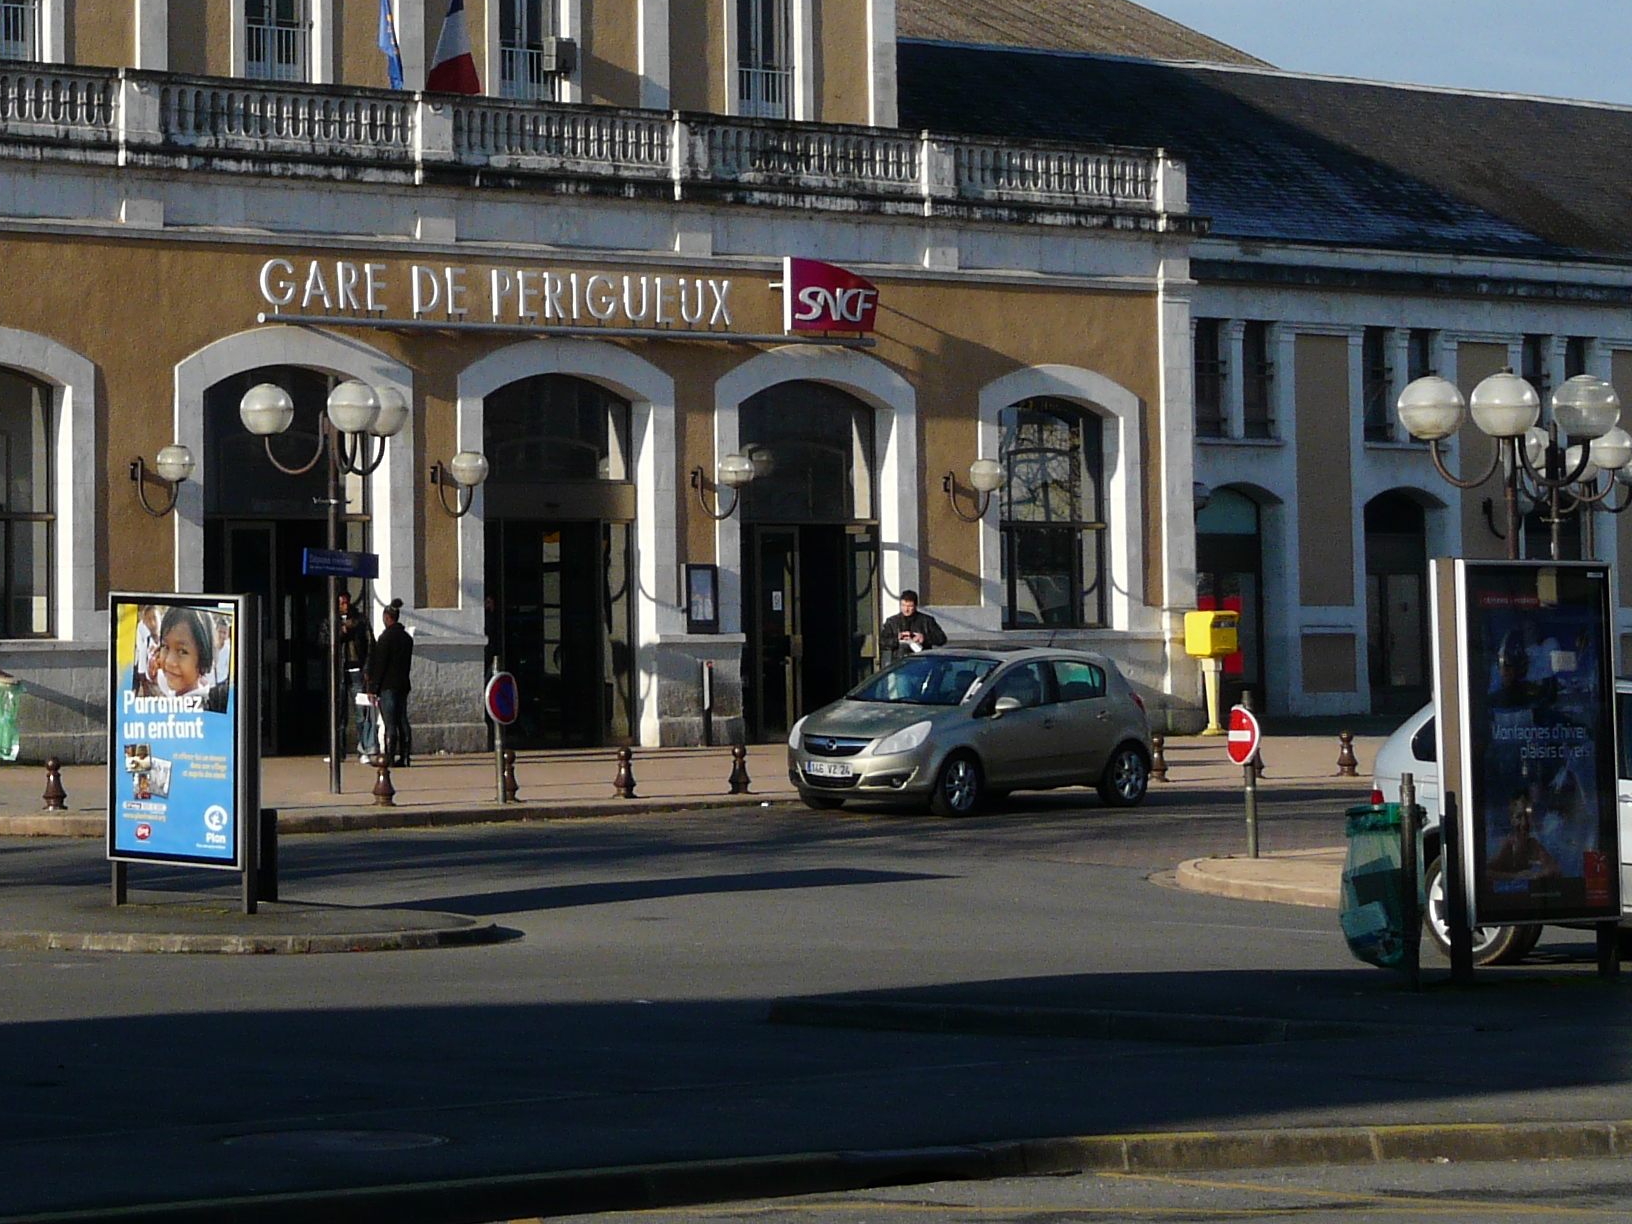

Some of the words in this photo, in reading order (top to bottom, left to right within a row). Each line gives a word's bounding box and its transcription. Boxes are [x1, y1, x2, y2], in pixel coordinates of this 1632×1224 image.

[259, 258, 388, 311] GARE
[411, 265, 467, 315] DE
[491, 269, 731, 325] PERIGUEUX
[794, 286, 878, 322] SNCF
[123, 689, 204, 714] Parrainez
[123, 721, 145, 739] un
[148, 714, 204, 739] enfant
[206, 832, 226, 844] Plan
